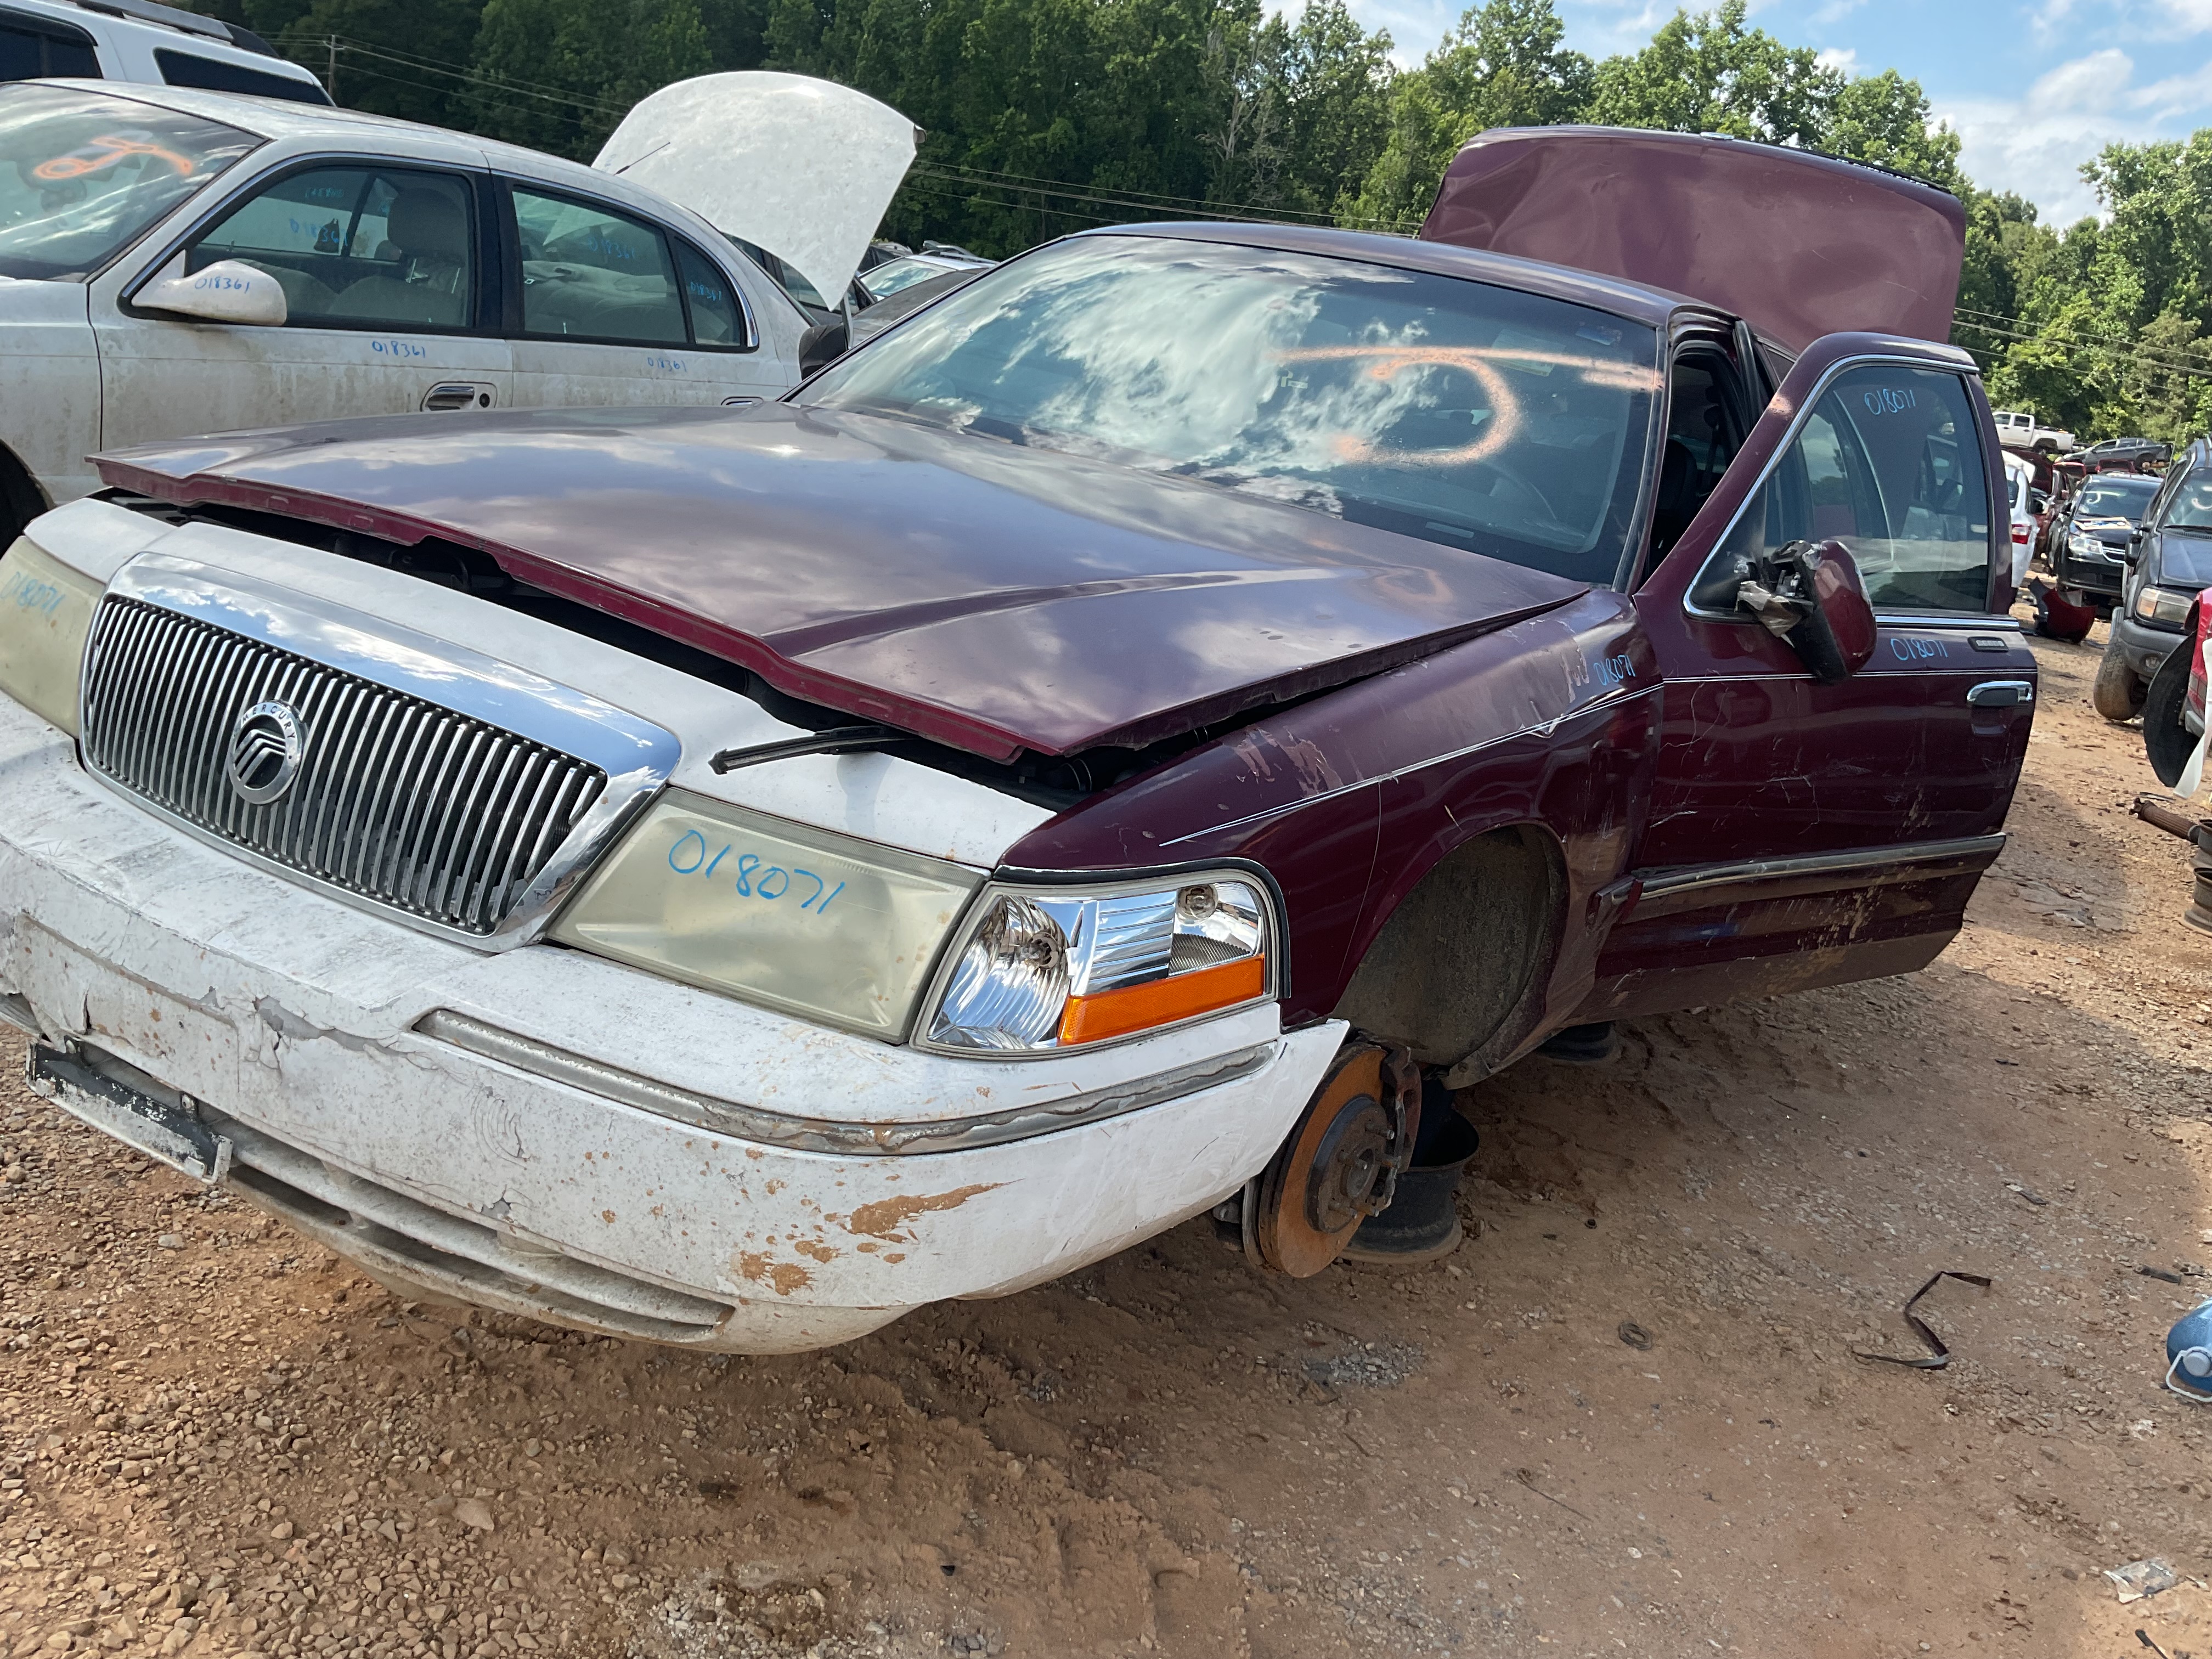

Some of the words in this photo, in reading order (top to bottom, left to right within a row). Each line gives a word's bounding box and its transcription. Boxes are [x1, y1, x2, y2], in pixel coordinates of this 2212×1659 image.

[195, 276, 250, 294] 018361
[372, 341, 425, 358] 018361
[647, 357, 687, 372] 018361
[1864, 388, 1916, 415] 018071
[0, 571, 65, 613] 018071
[1890, 637, 1948, 661] 018071
[1593, 654, 1636, 685] 018071
[242, 704, 296, 739] MERCURY
[669, 830, 845, 915] 018071
